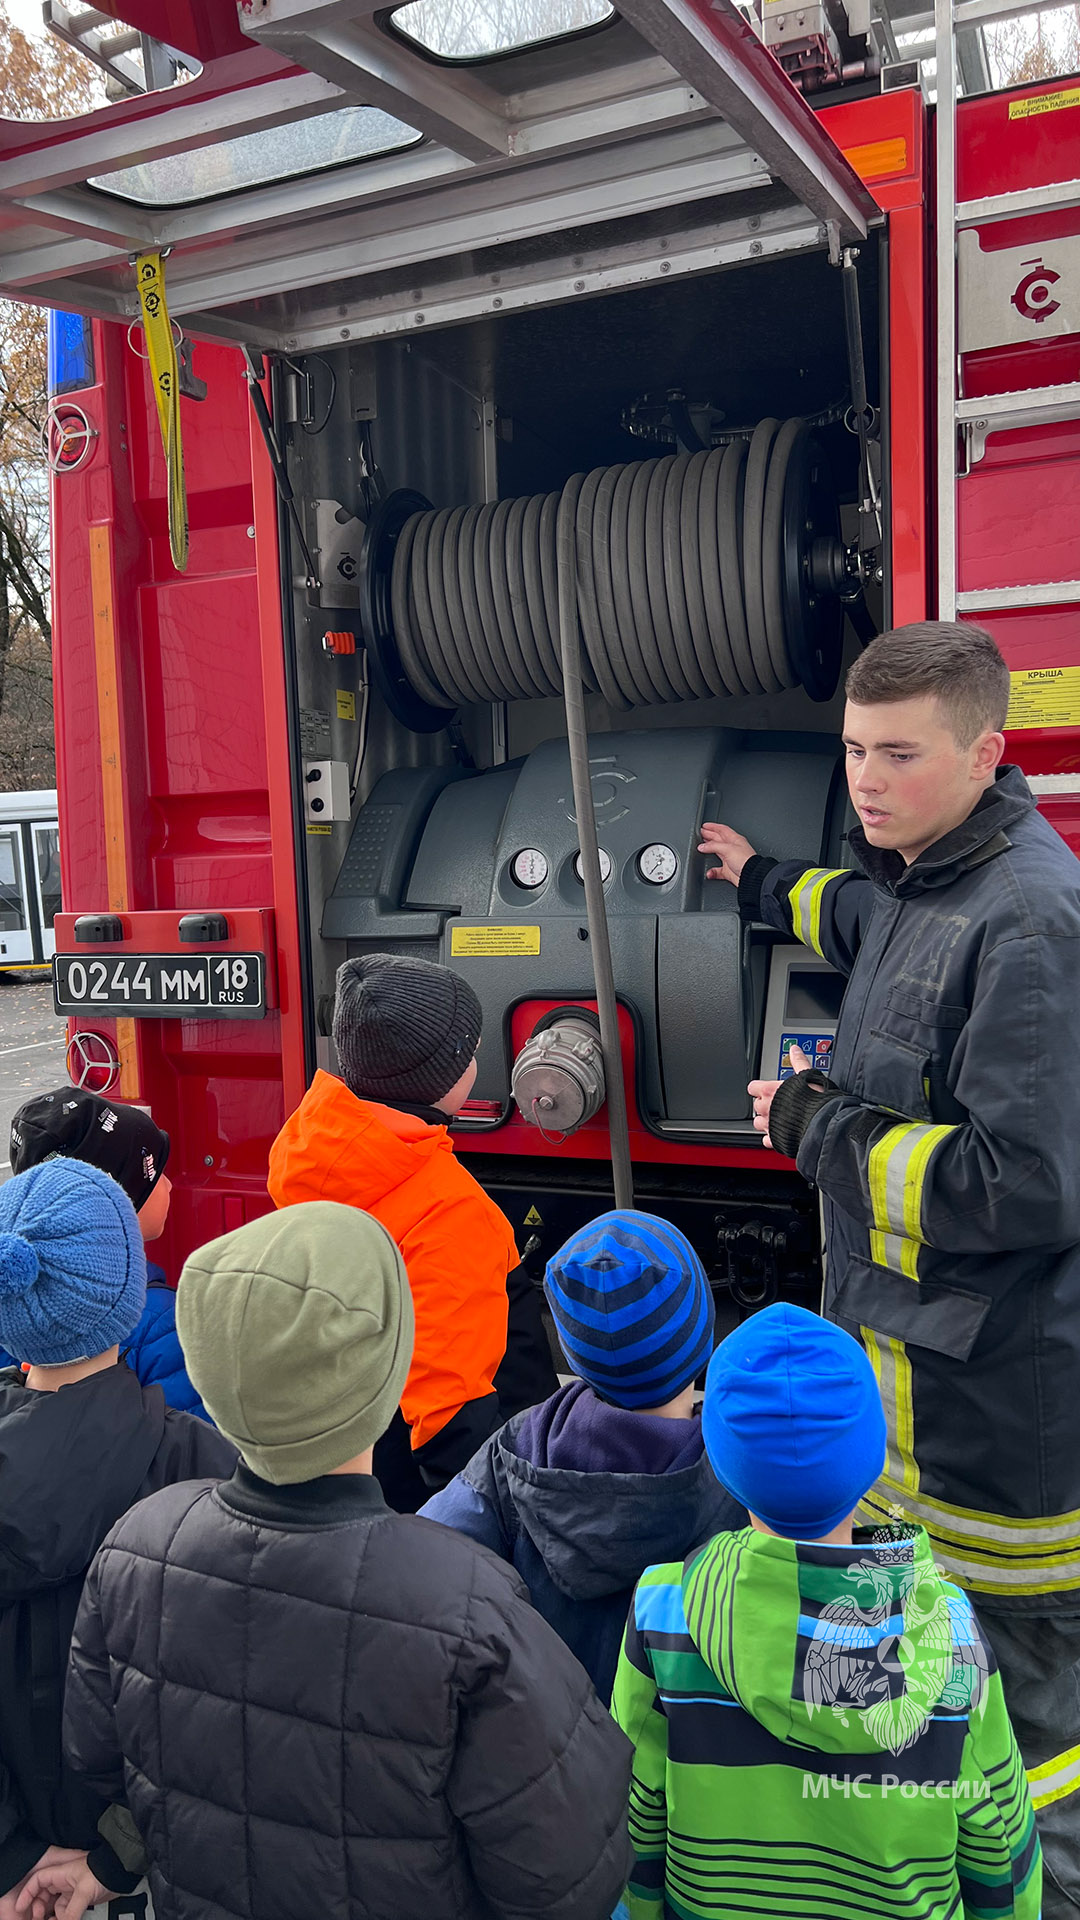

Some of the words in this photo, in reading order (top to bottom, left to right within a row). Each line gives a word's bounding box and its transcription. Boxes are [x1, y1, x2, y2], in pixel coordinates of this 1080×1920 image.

[1011, 104, 1049, 117] ОПАСНОСТЬ
[1050, 97, 1080, 108] ПАДЕНИЯ
[1028, 670, 1063, 679] КРЫША
[68, 961, 151, 1000] 0244
[160, 970, 205, 1000] ММ
[215, 959, 248, 990] 18
[218, 991, 244, 1003] RUS
